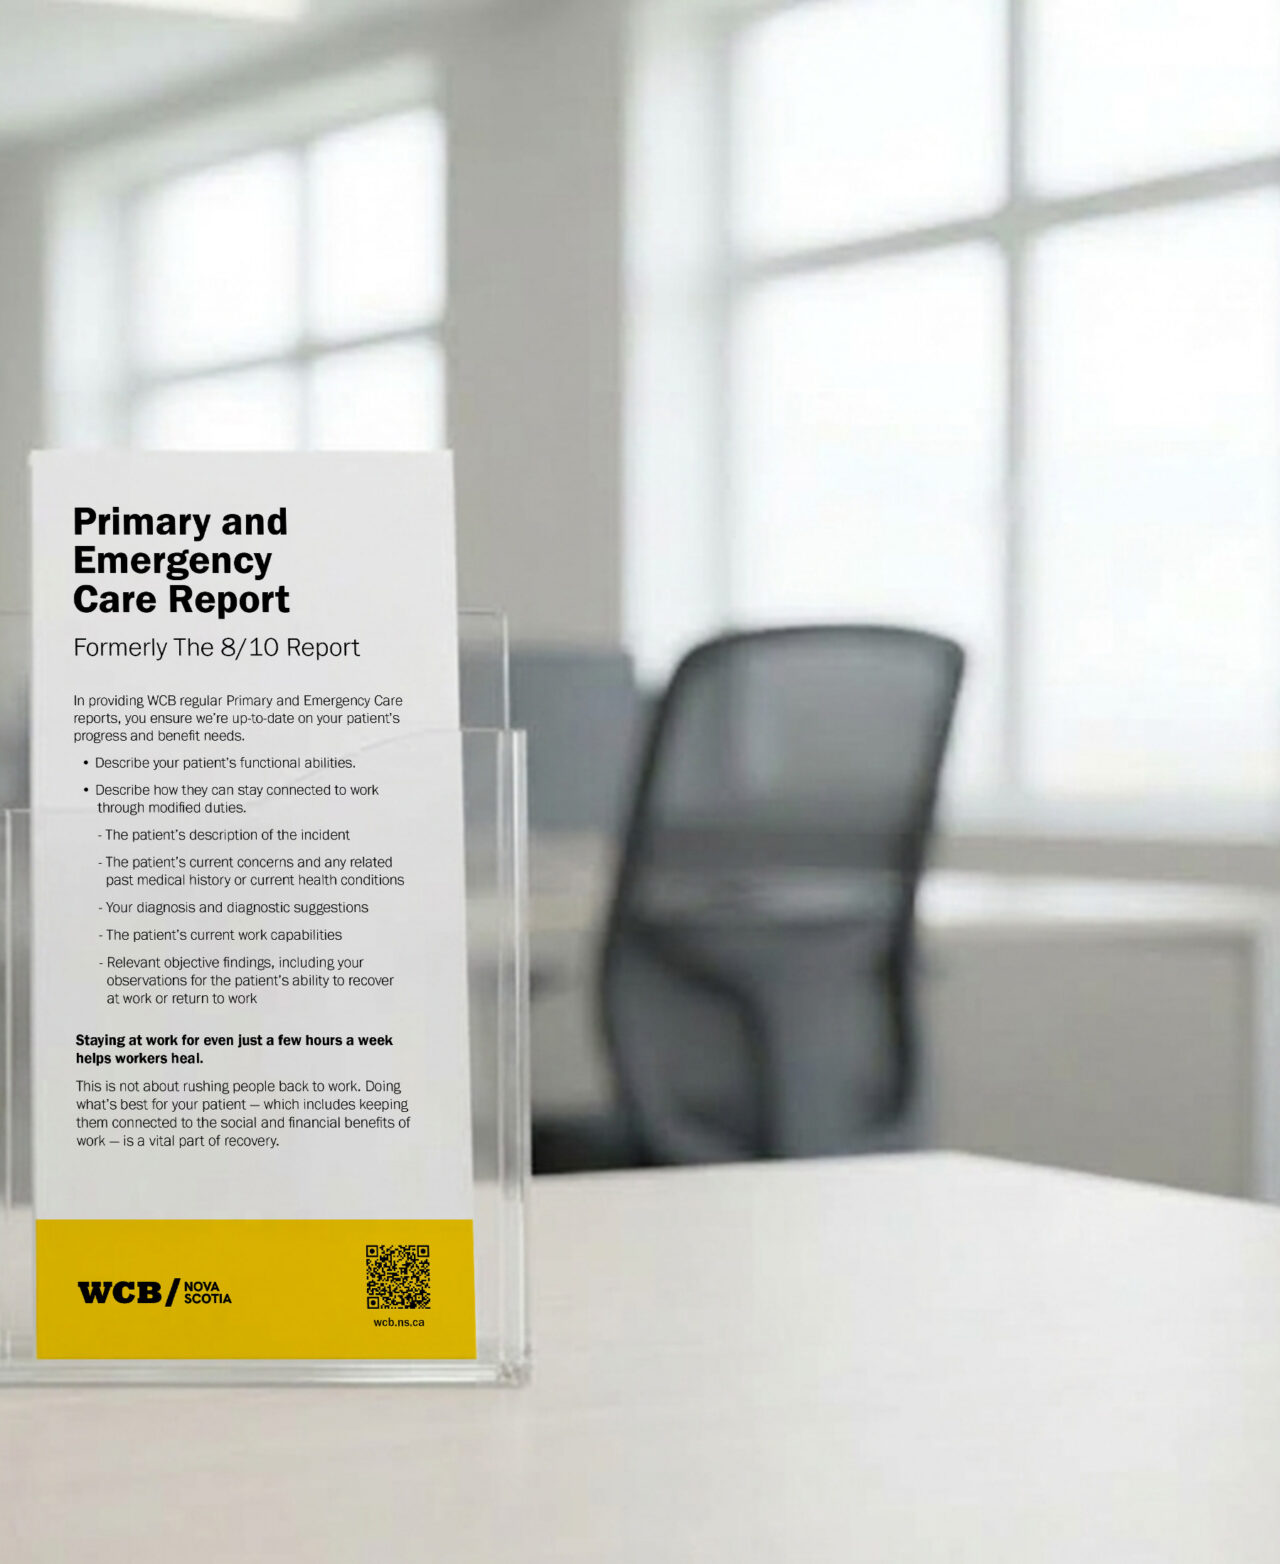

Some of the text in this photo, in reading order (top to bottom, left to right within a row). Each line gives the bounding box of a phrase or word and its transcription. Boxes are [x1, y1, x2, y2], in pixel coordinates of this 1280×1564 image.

[74, 506, 287, 542] Primary and
[74, 545, 272, 580] Emergency
[73, 584, 290, 620] Care Report
[75, 637, 361, 661] Formerly The 8/10 Report
[74, 694, 403, 709] In providing WCB regular Primary and Emergency Care
[74, 729, 245, 744] progress and benefit needs.
[95, 757, 150, 769] Describe
[153, 759, 180, 771] your
[240, 756, 301, 769] functional
[304, 757, 356, 769] abilities.
[95, 784, 379, 798] Describe how they can stay connected to work
[97, 801, 246, 816] through modified duties.
[105, 829, 129, 841] The
[189, 829, 258, 843] description
[261, 828, 274, 841] of
[276, 829, 298, 841] the
[301, 829, 350, 841] incident
[105, 901, 369, 916] Your diagnosis and diagnostic suggestions
[106, 929, 130, 941] The
[190, 930, 235, 941] current
[238, 929, 268, 941] work
[270, 929, 343, 943] capabilities
[107, 956, 364, 971] Relevant objective findings, including your
[106, 992, 258, 1005] at work or return to work
[75, 1034, 394, 1048] Staying at work for even just a few hours a week
[76, 1052, 203, 1066] helps workers heal.
[75, 1080, 402, 1095] This is not about rushing people back to work. Doing
[76, 1134, 279, 1149] work is a vital part of recovery.
[184, 1281, 220, 1292] NOVA
[184, 1293, 232, 1304] SCOTIA
[373, 1317, 425, 1327] wcb.ns.ca
